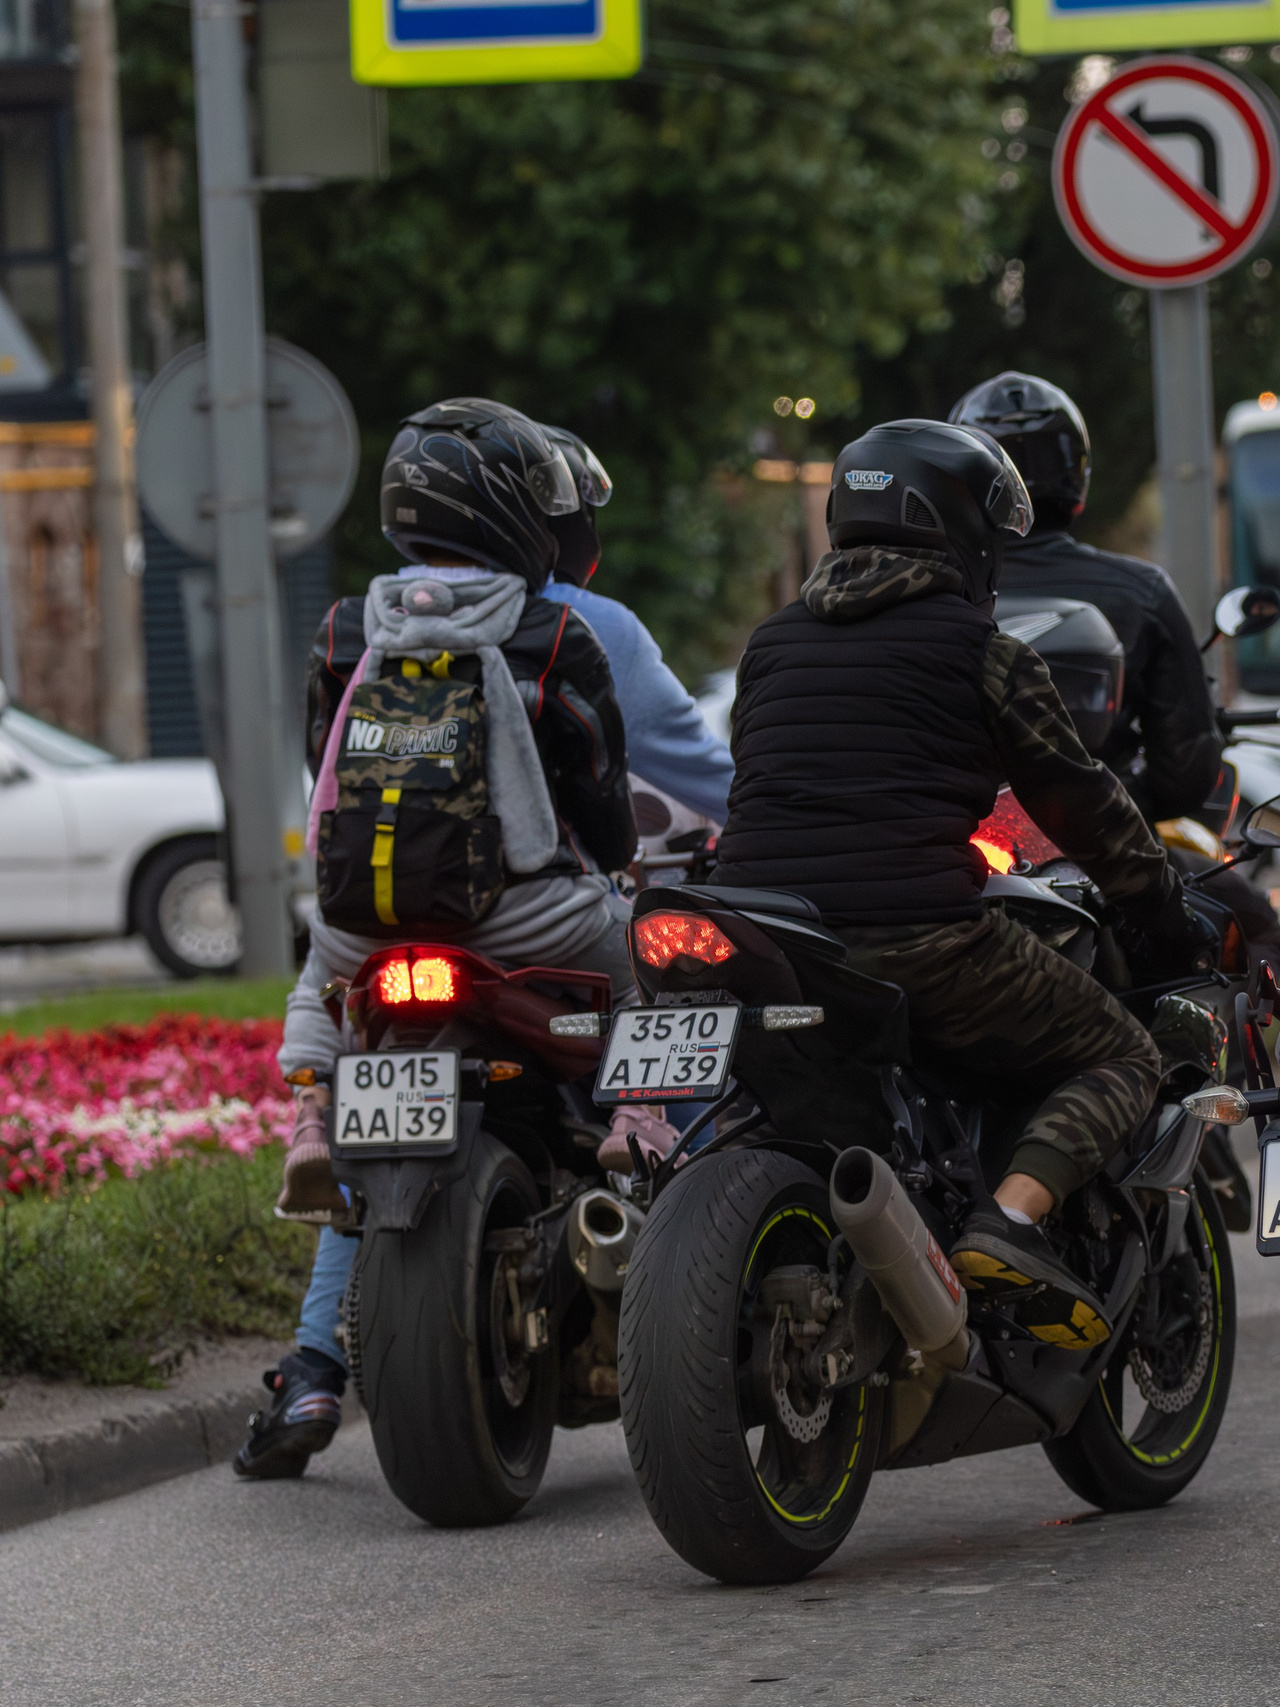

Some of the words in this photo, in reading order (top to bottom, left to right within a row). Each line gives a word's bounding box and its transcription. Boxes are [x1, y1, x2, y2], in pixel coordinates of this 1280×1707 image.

[851, 473, 884, 484] DRAG
[346, 718, 385, 751] NO
[385, 721, 459, 755] PANIC
[630, 1011, 719, 1042] 3510
[669, 1043, 698, 1053] RUS
[354, 1056, 439, 1090] 8015
[605, 1057, 661, 1087] AT
[672, 1055, 718, 1083] 39
[396, 1091, 423, 1103] RUS
[643, 1087, 695, 1097] Kawasaki
[341, 1108, 390, 1139] AA
[406, 1106, 447, 1137] 39
